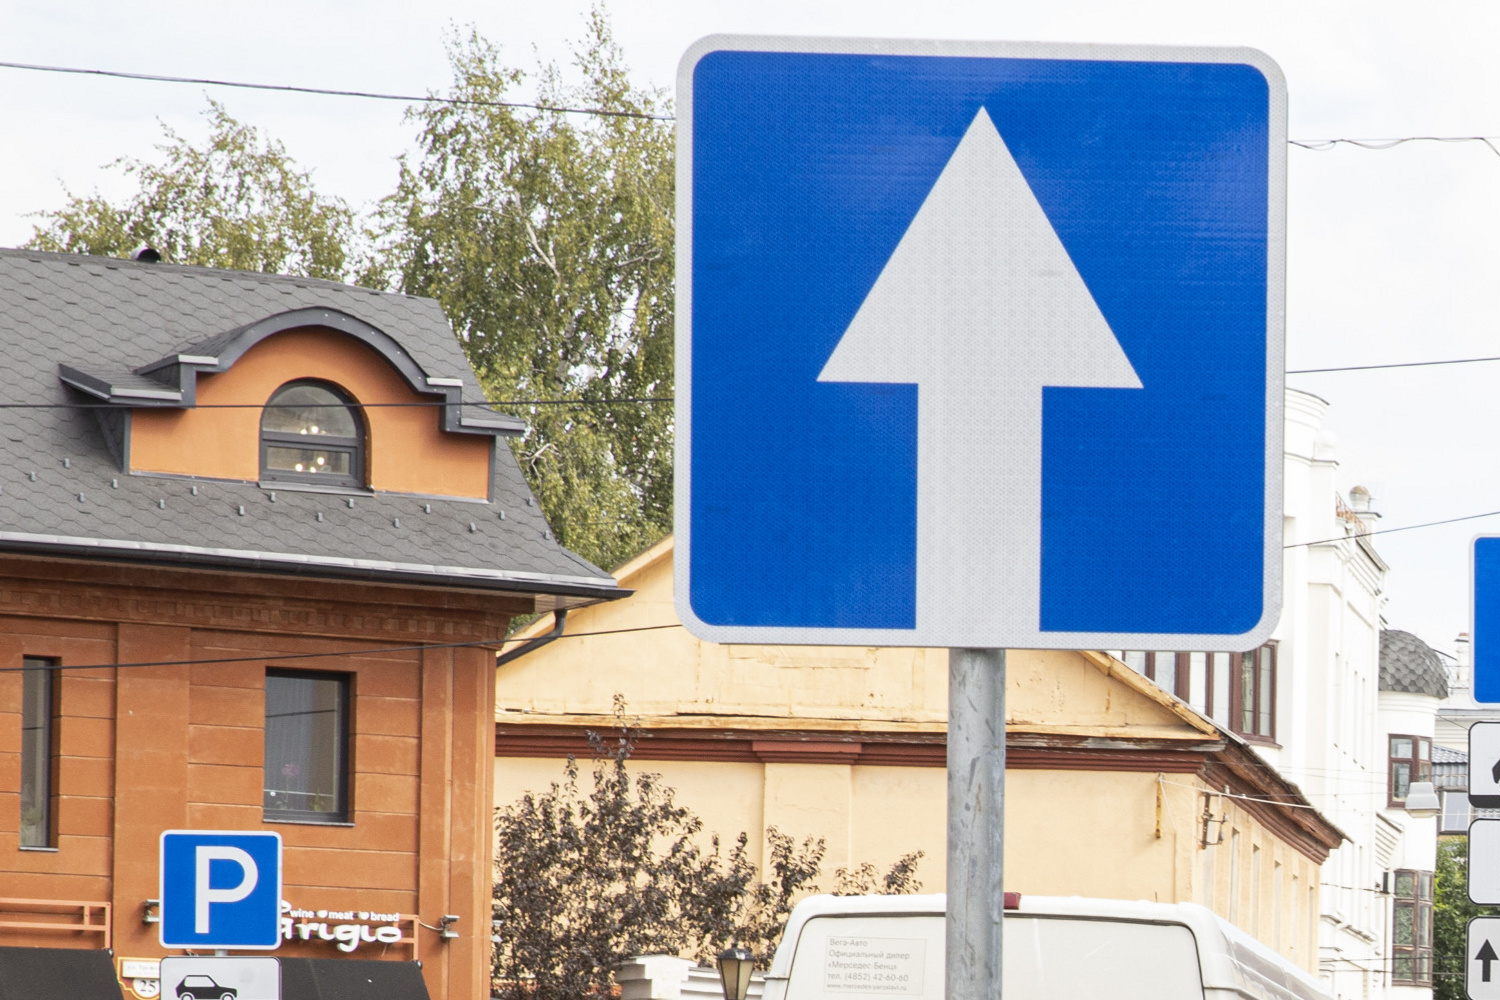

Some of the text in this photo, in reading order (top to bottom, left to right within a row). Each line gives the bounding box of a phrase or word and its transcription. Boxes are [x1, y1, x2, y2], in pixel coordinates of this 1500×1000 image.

[195, 846, 258, 933] P
[290, 908, 400, 922] wine meat bread
[281, 899, 402, 952] rigio
[828, 949, 910, 960] Официальный дилер
[844, 972, 870, 981] (4852)
[140, 980, 156, 993] 25
